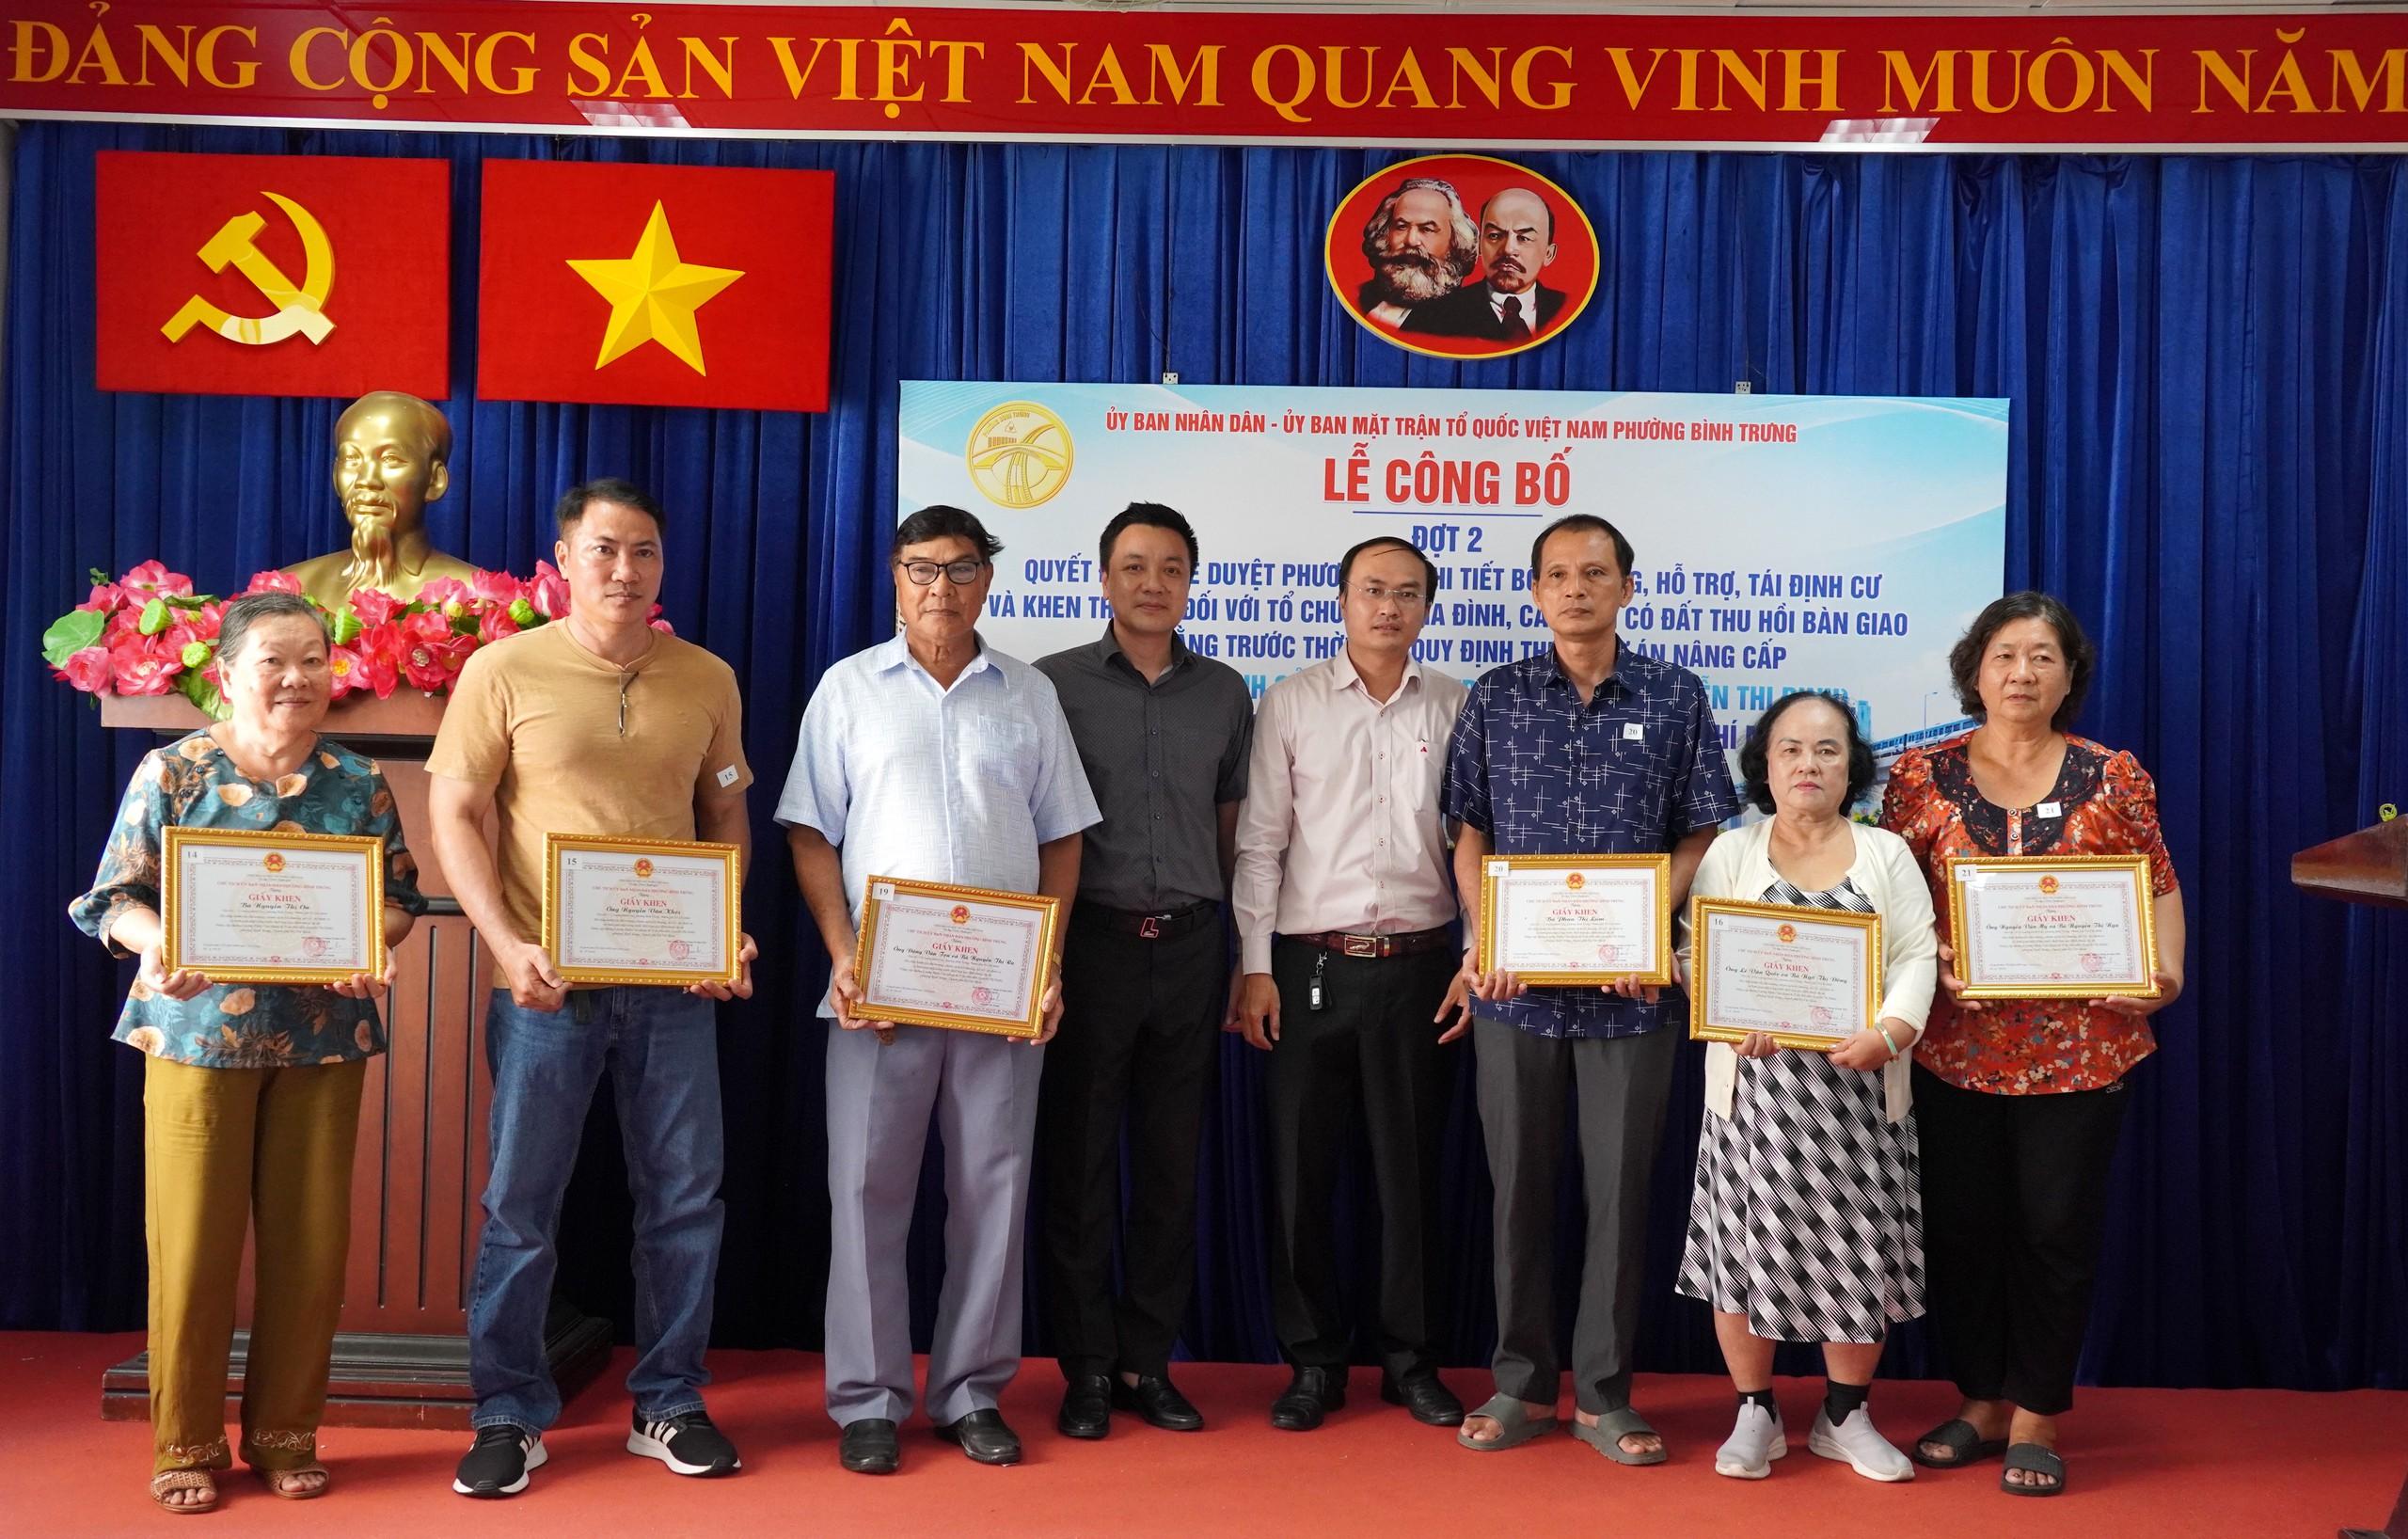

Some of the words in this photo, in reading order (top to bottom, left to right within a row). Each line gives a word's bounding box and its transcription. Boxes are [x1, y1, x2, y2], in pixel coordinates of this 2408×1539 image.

[8, 2, 259, 89] ĐẢNG
[289, 18, 542, 110] CỘNG
[567, 12, 737, 100] SẢN
[766, 18, 985, 119] VIỆT
[1016, 42, 1227, 107] NAM
[1252, 43, 1578, 123] QUANG
[1604, 47, 1846, 113] VINH
[1877, 37, 2160, 114] MUÔN
[2191, 26, 2408, 114] NĂM
[1106, 406, 1129, 431] ỦY
[1134, 412, 1169, 432] BAN
[1176, 410, 1223, 433] NHÂN
[1229, 410, 1265, 433] DÂN
[1283, 408, 1305, 434] ỦY
[1311, 416, 1346, 435] BAN
[1353, 413, 1389, 439] MẶT
[1395, 414, 1440, 440] TRẬN
[1446, 411, 1468, 437] TỔ
[1473, 412, 1519, 438] QUỐC
[1525, 416, 1561, 442] VIỆT
[1567, 420, 1608, 439] NAM
[1613, 419, 1685, 441] PHƯỜNG
[1691, 419, 1734, 442] BÌNH
[1739, 422, 1797, 443] TRƯNG
[1324, 442, 1370, 502] LỄ
[1386, 451, 1501, 506] CÔNG
[1515, 446, 1573, 506] BỐ
[1412, 523, 1460, 557] ĐỢT
[1467, 527, 1482, 553] 2
[1025, 553, 1092, 585] QUYẾT
[1208, 559, 1275, 591] DUYỆT
[1282, 562, 1341, 588] PHƯƠ
[1460, 560, 1505, 591] TIẾT
[1656, 563, 1686, 595] HỖ
[1693, 570, 1740, 601] TRỢ,
[1749, 568, 1782, 597] TÁI
[1789, 574, 1843, 603] ĐỊNH
[1851, 574, 1882, 599] CƯ
[989, 590, 1016, 618] VÀ
[1023, 595, 1081, 619] KHEN
[1226, 594, 1259, 623] VỚI
[1267, 590, 1294, 623] TỔ
[1452, 598, 1512, 630] ĐÌNH,
[1625, 602, 1654, 630] CÓ
[1661, 599, 1703, 631] ĐẤT
[1710, 609, 1751, 632] THU
[1759, 603, 1795, 634] HỒI
[1803, 607, 1848, 635] BÀN
[1857, 612, 1908, 636] GIAO
[1226, 630, 1295, 658] TRƯỚC
[1304, 631, 1348, 659] THỜ
[1411, 639, 1453, 664] QUY
[1460, 640, 1513, 668] ĐỊNH
[1673, 640, 1735, 669] NÂNG
[1743, 639, 1786, 670] CẤP
[725, 770, 734, 781] 15
[187, 850, 198, 859] 14
[566, 857, 578, 865] 15
[1961, 869, 1972, 878] 21
[879, 887, 889, 896] 19
[620, 896, 642, 906] GIẤY
[643, 899, 668, 908] KHEN
[1714, 918, 1724, 927] 16
[932, 941, 952, 952] GIẤY
[955, 945, 979, 955] KHEN
[1786, 963, 1809, 973] KHEN
